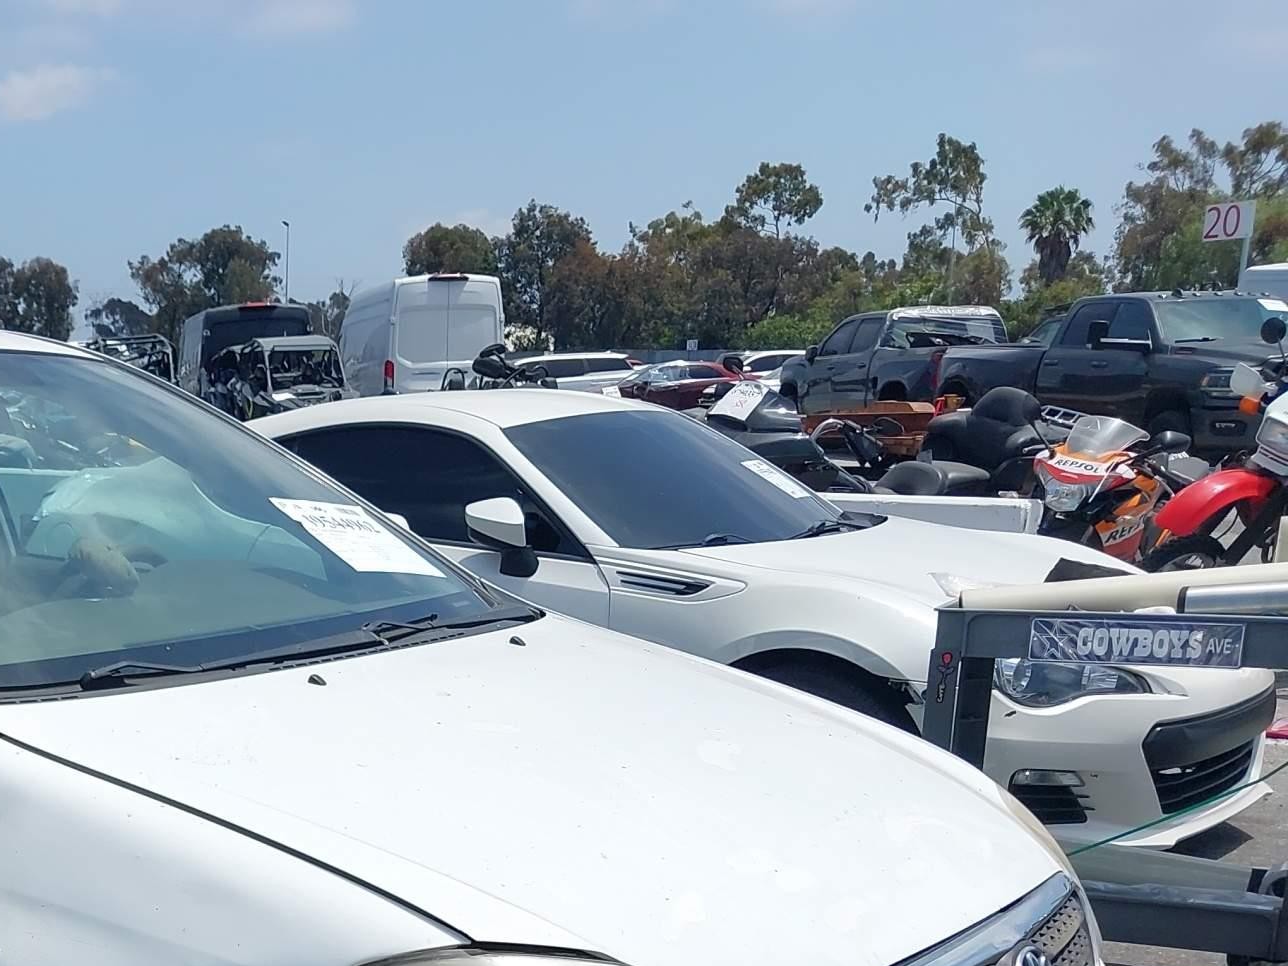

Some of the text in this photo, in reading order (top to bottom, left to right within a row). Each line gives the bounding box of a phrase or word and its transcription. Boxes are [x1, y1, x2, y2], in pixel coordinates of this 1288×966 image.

[1203, 204, 1241, 240] 20
[1053, 457, 1101, 474] REPSOL
[1076, 626, 1233, 660] COWBOYS AVE
